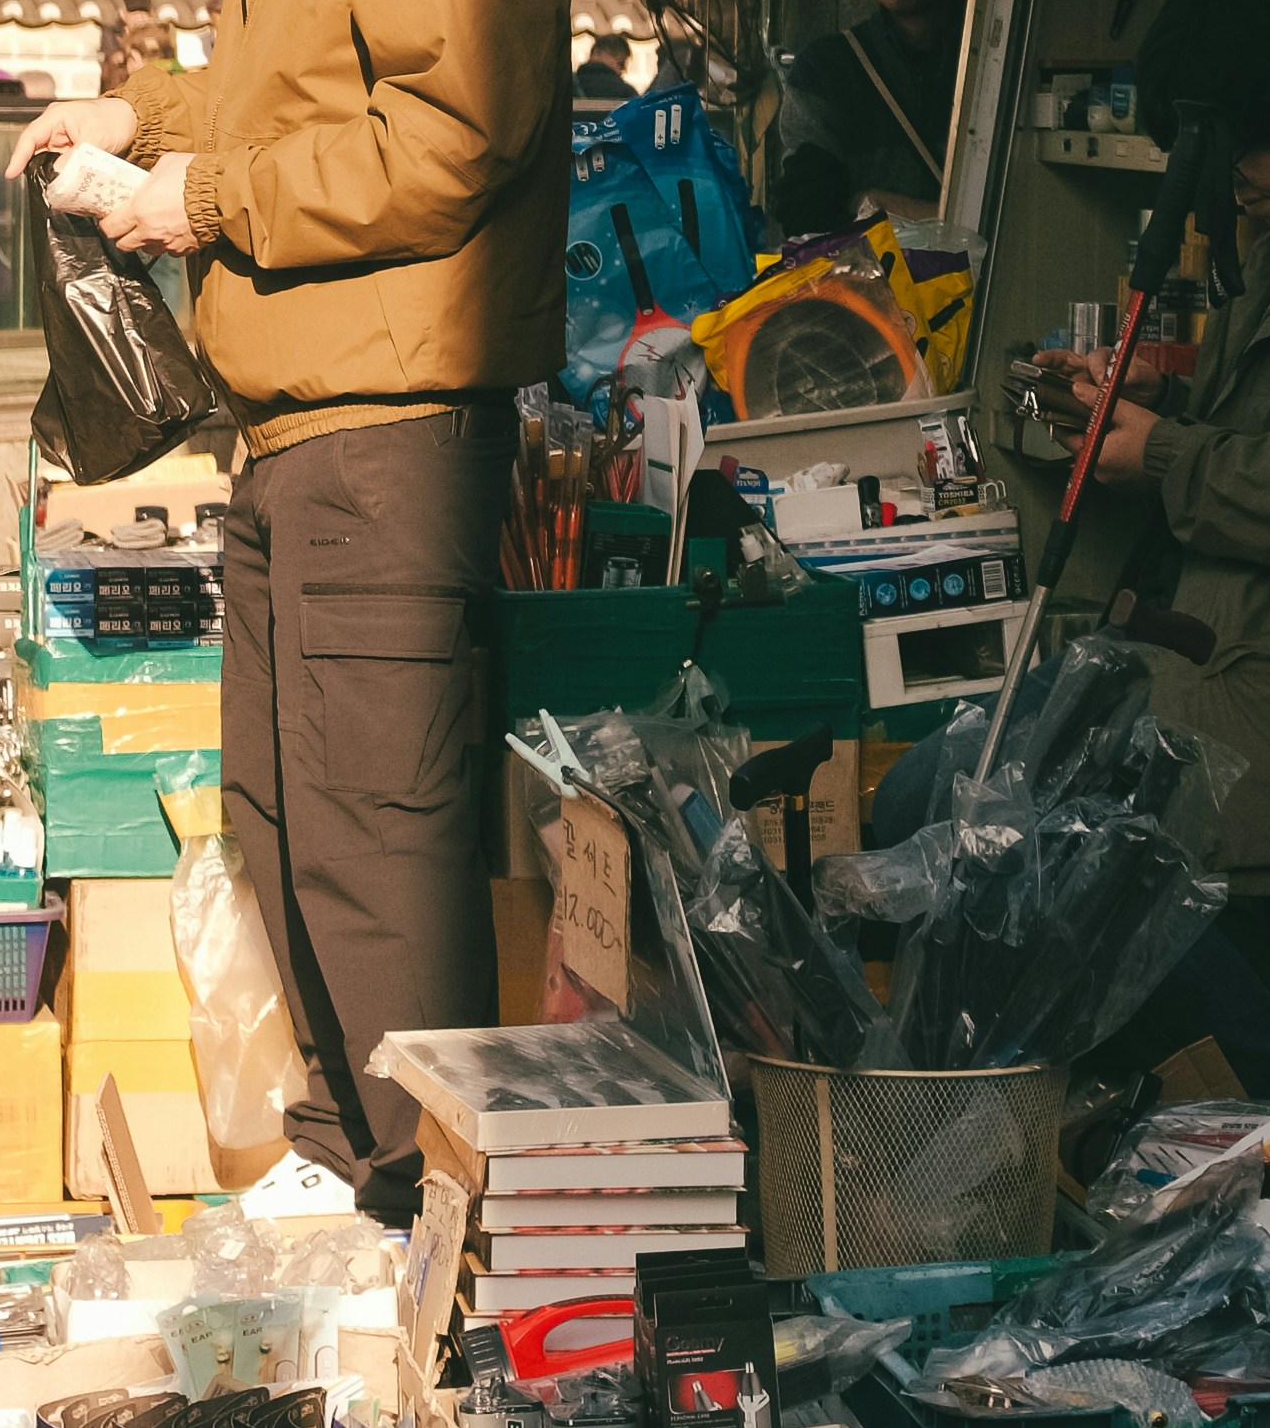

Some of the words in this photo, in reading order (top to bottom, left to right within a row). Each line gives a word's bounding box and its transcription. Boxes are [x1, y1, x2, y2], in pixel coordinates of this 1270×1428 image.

[937, 489, 975, 499] TOSHIBA
[309, 536, 350, 547] EIDER
[241, 1327, 263, 1337] EAR
